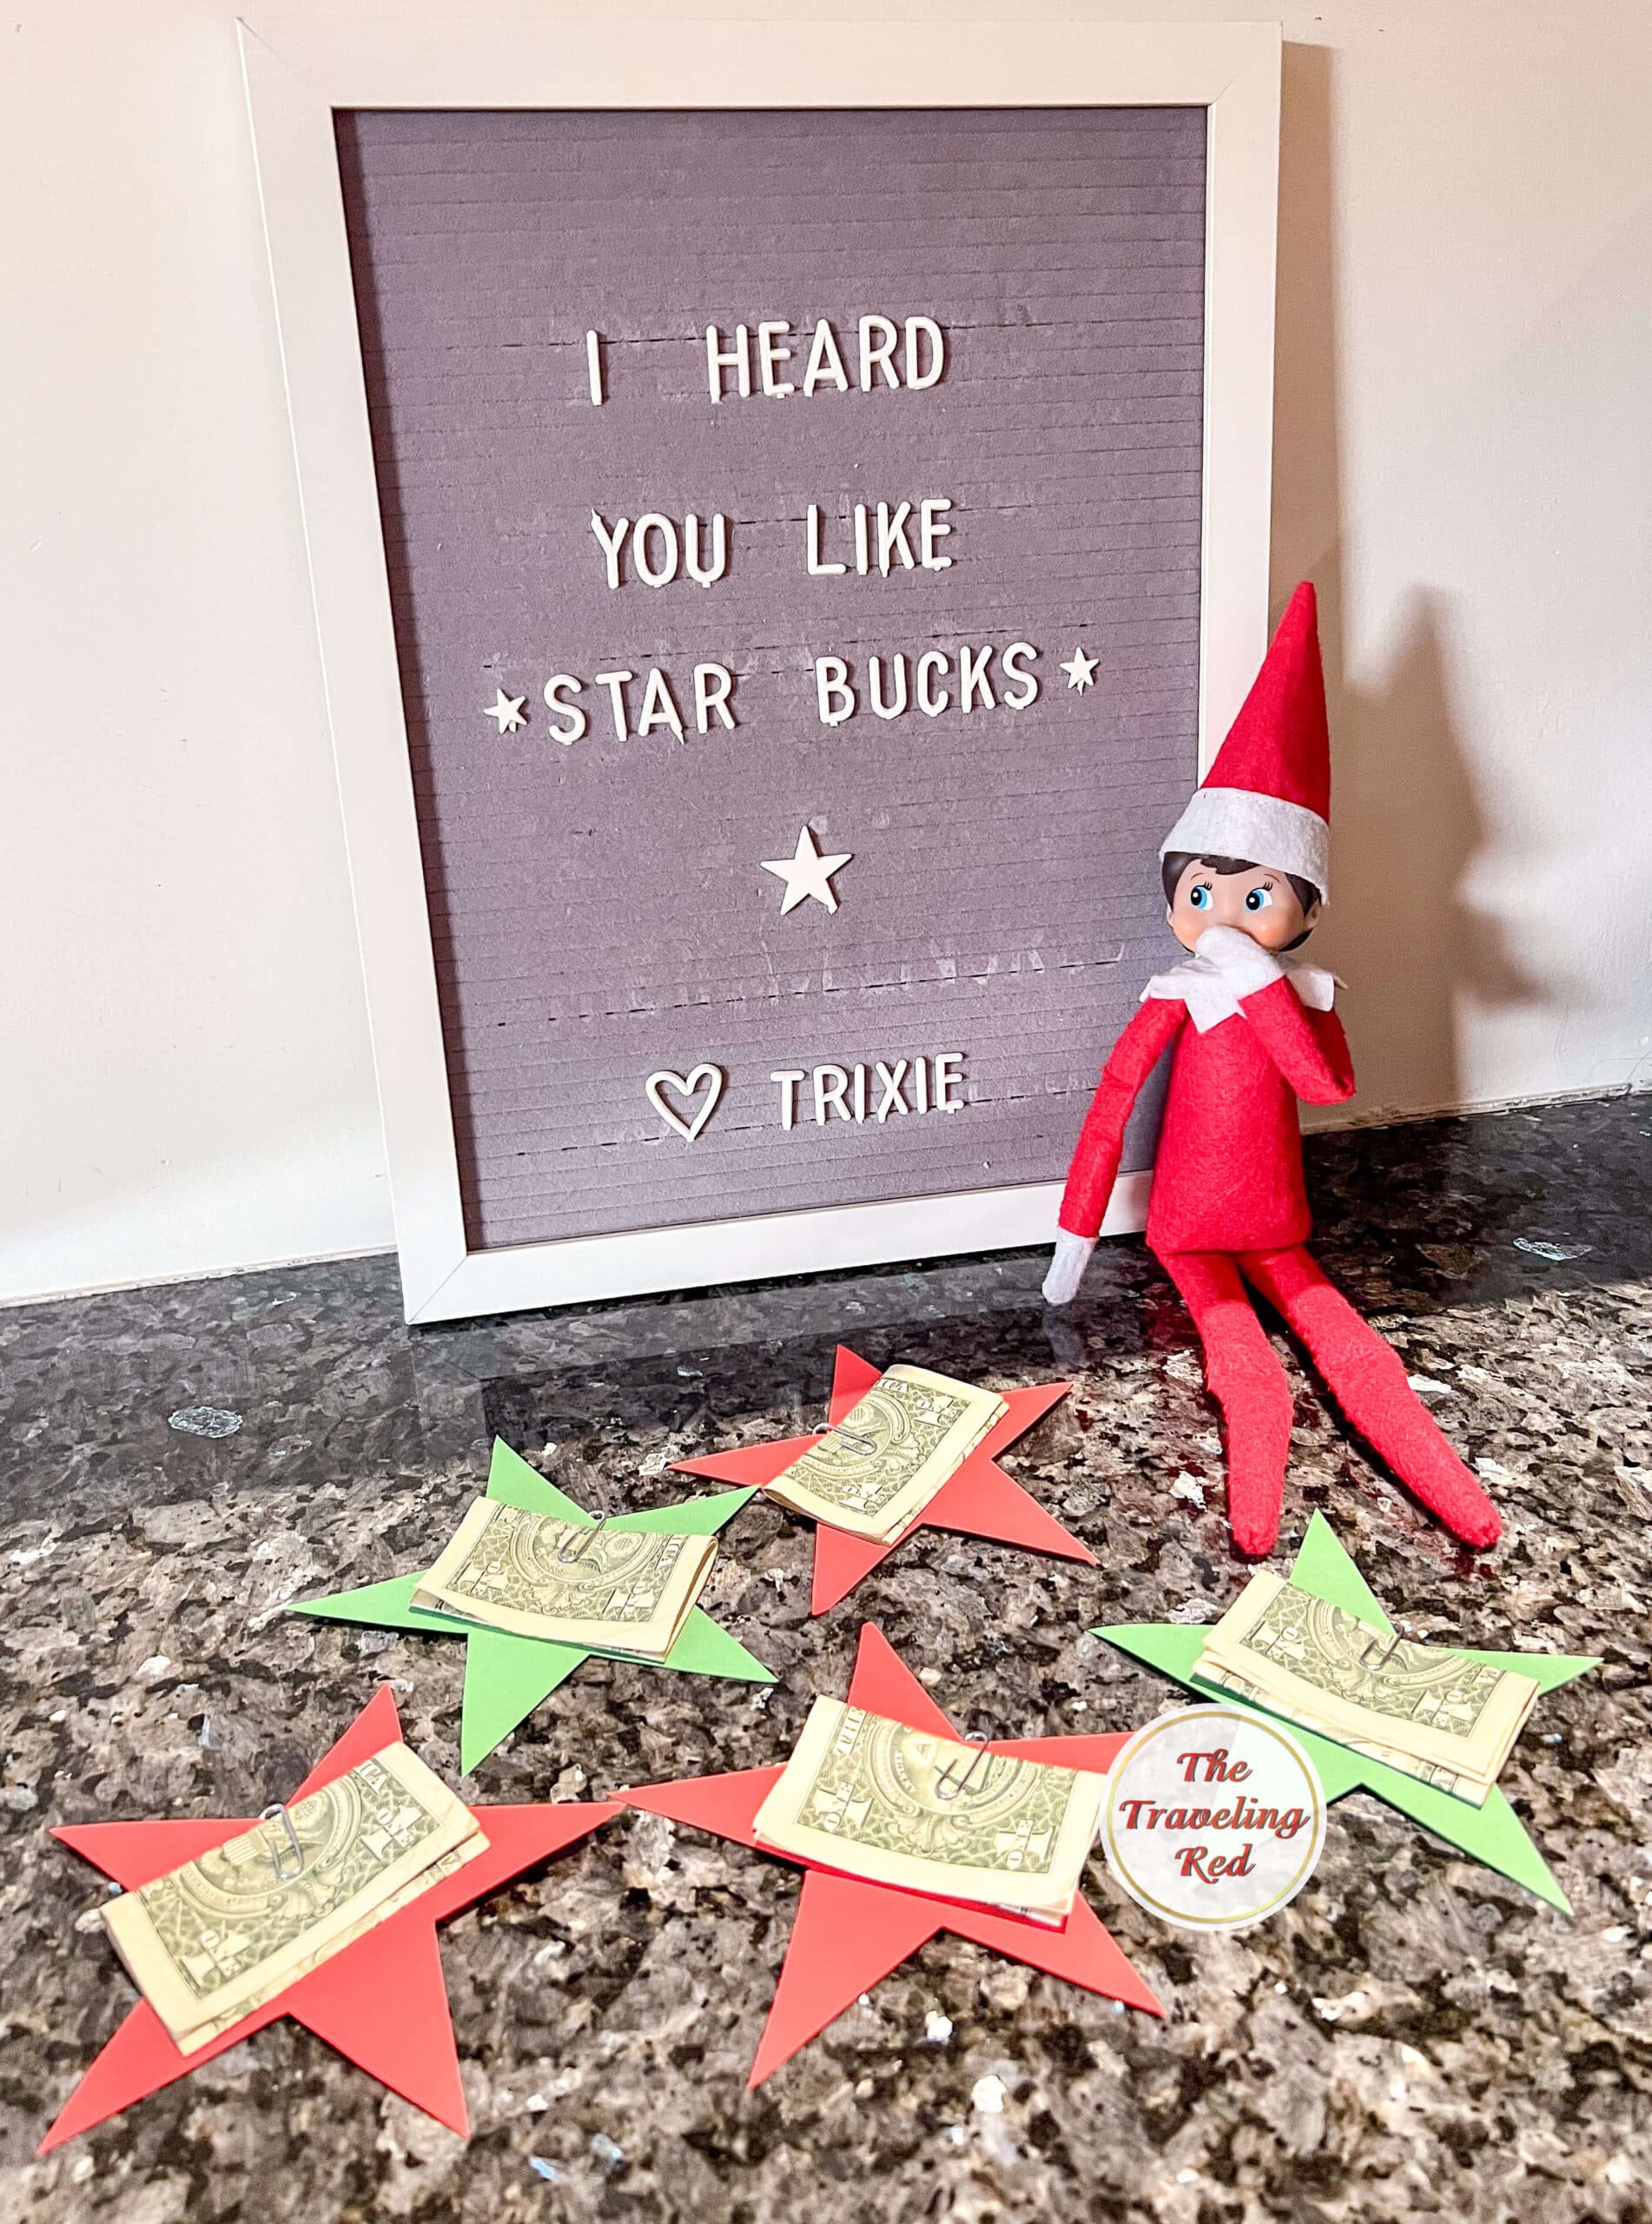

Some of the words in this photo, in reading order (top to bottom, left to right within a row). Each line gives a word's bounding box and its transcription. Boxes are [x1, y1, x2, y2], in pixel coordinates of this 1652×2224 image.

[586, 330, 602, 406] I
[706, 315, 944, 403] HEARD
[591, 508, 726, 589] YOU
[807, 499, 953, 577] LIKE
[543, 663, 736, 745] STAR
[815, 642, 1040, 726] BUCKS
[770, 1052, 964, 1130] TRIXIE
